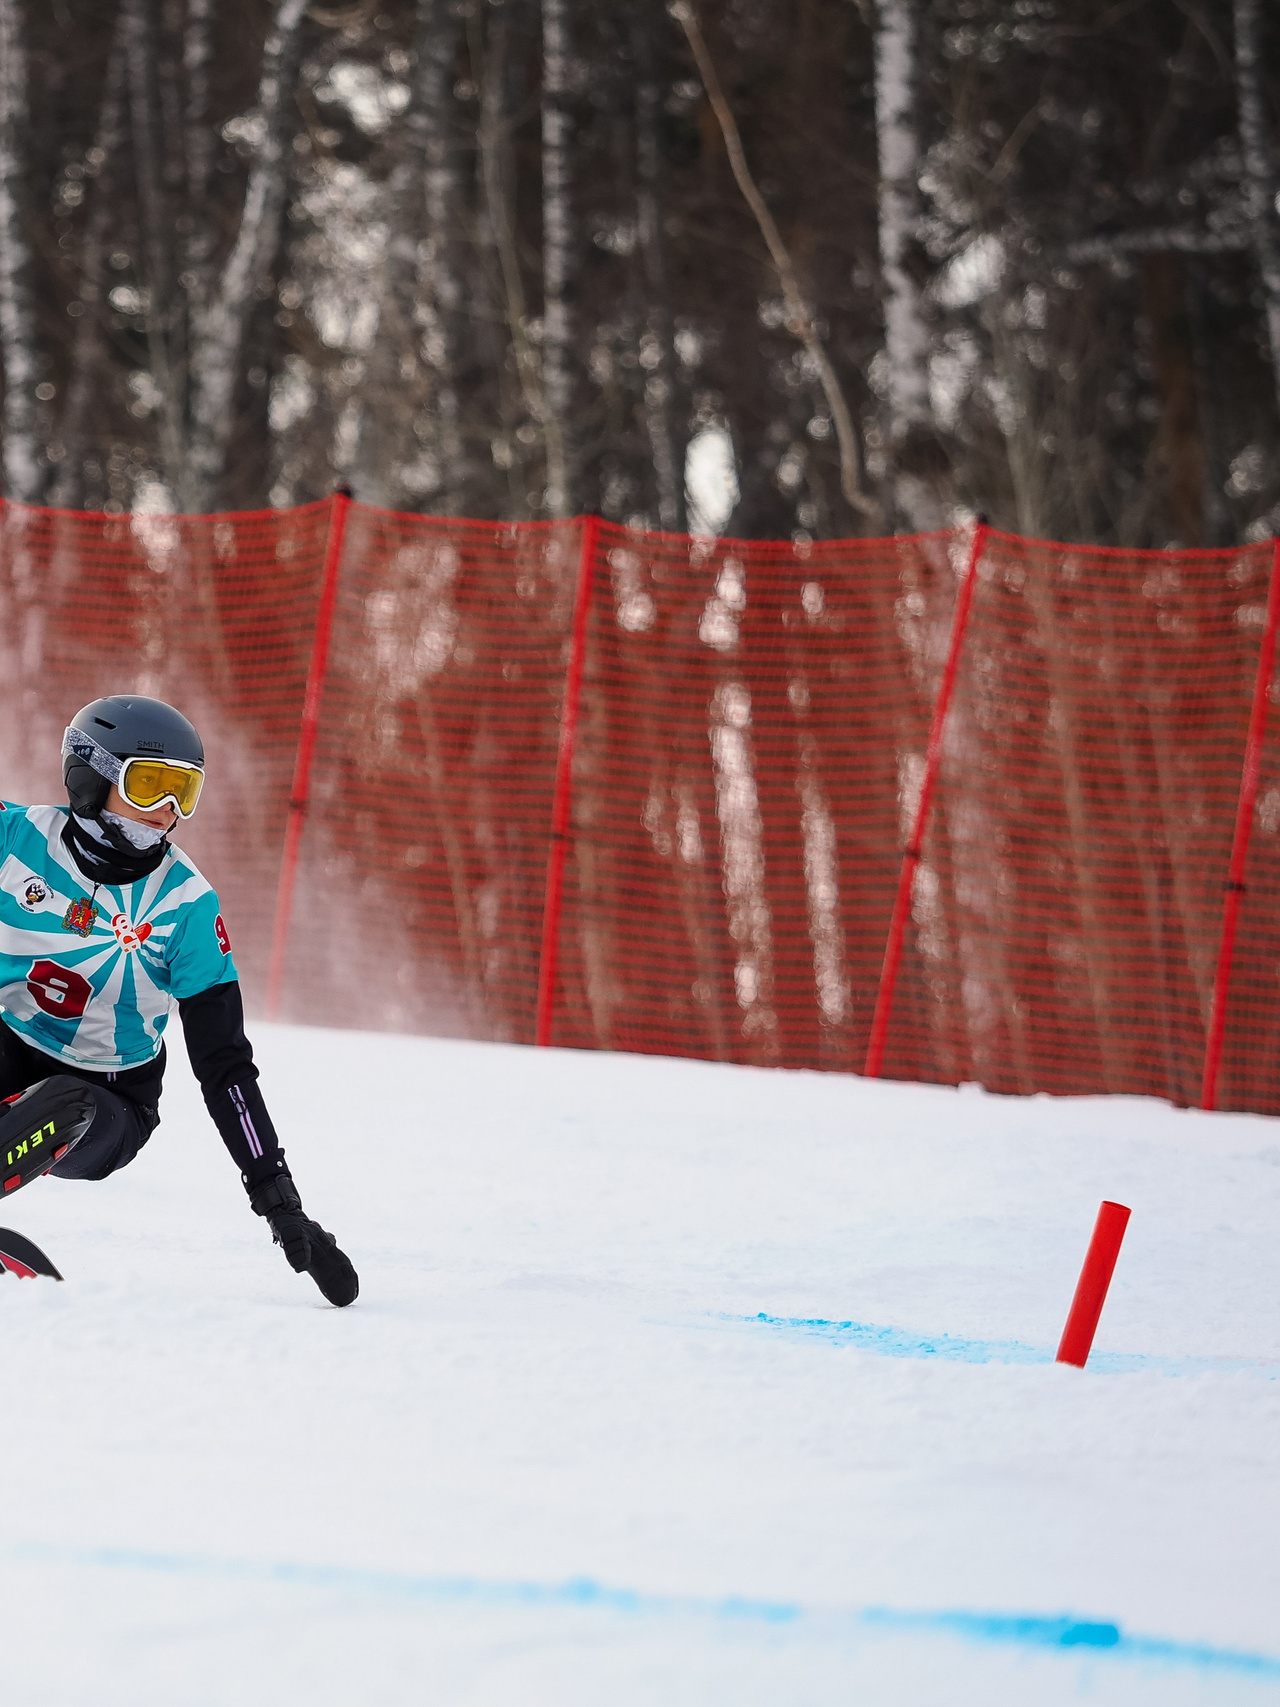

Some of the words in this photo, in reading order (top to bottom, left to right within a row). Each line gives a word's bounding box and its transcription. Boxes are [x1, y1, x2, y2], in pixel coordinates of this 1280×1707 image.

[136, 740, 165, 750] SMITH
[26, 958, 95, 1020] 9
[6, 1120, 56, 1166] LEKI
